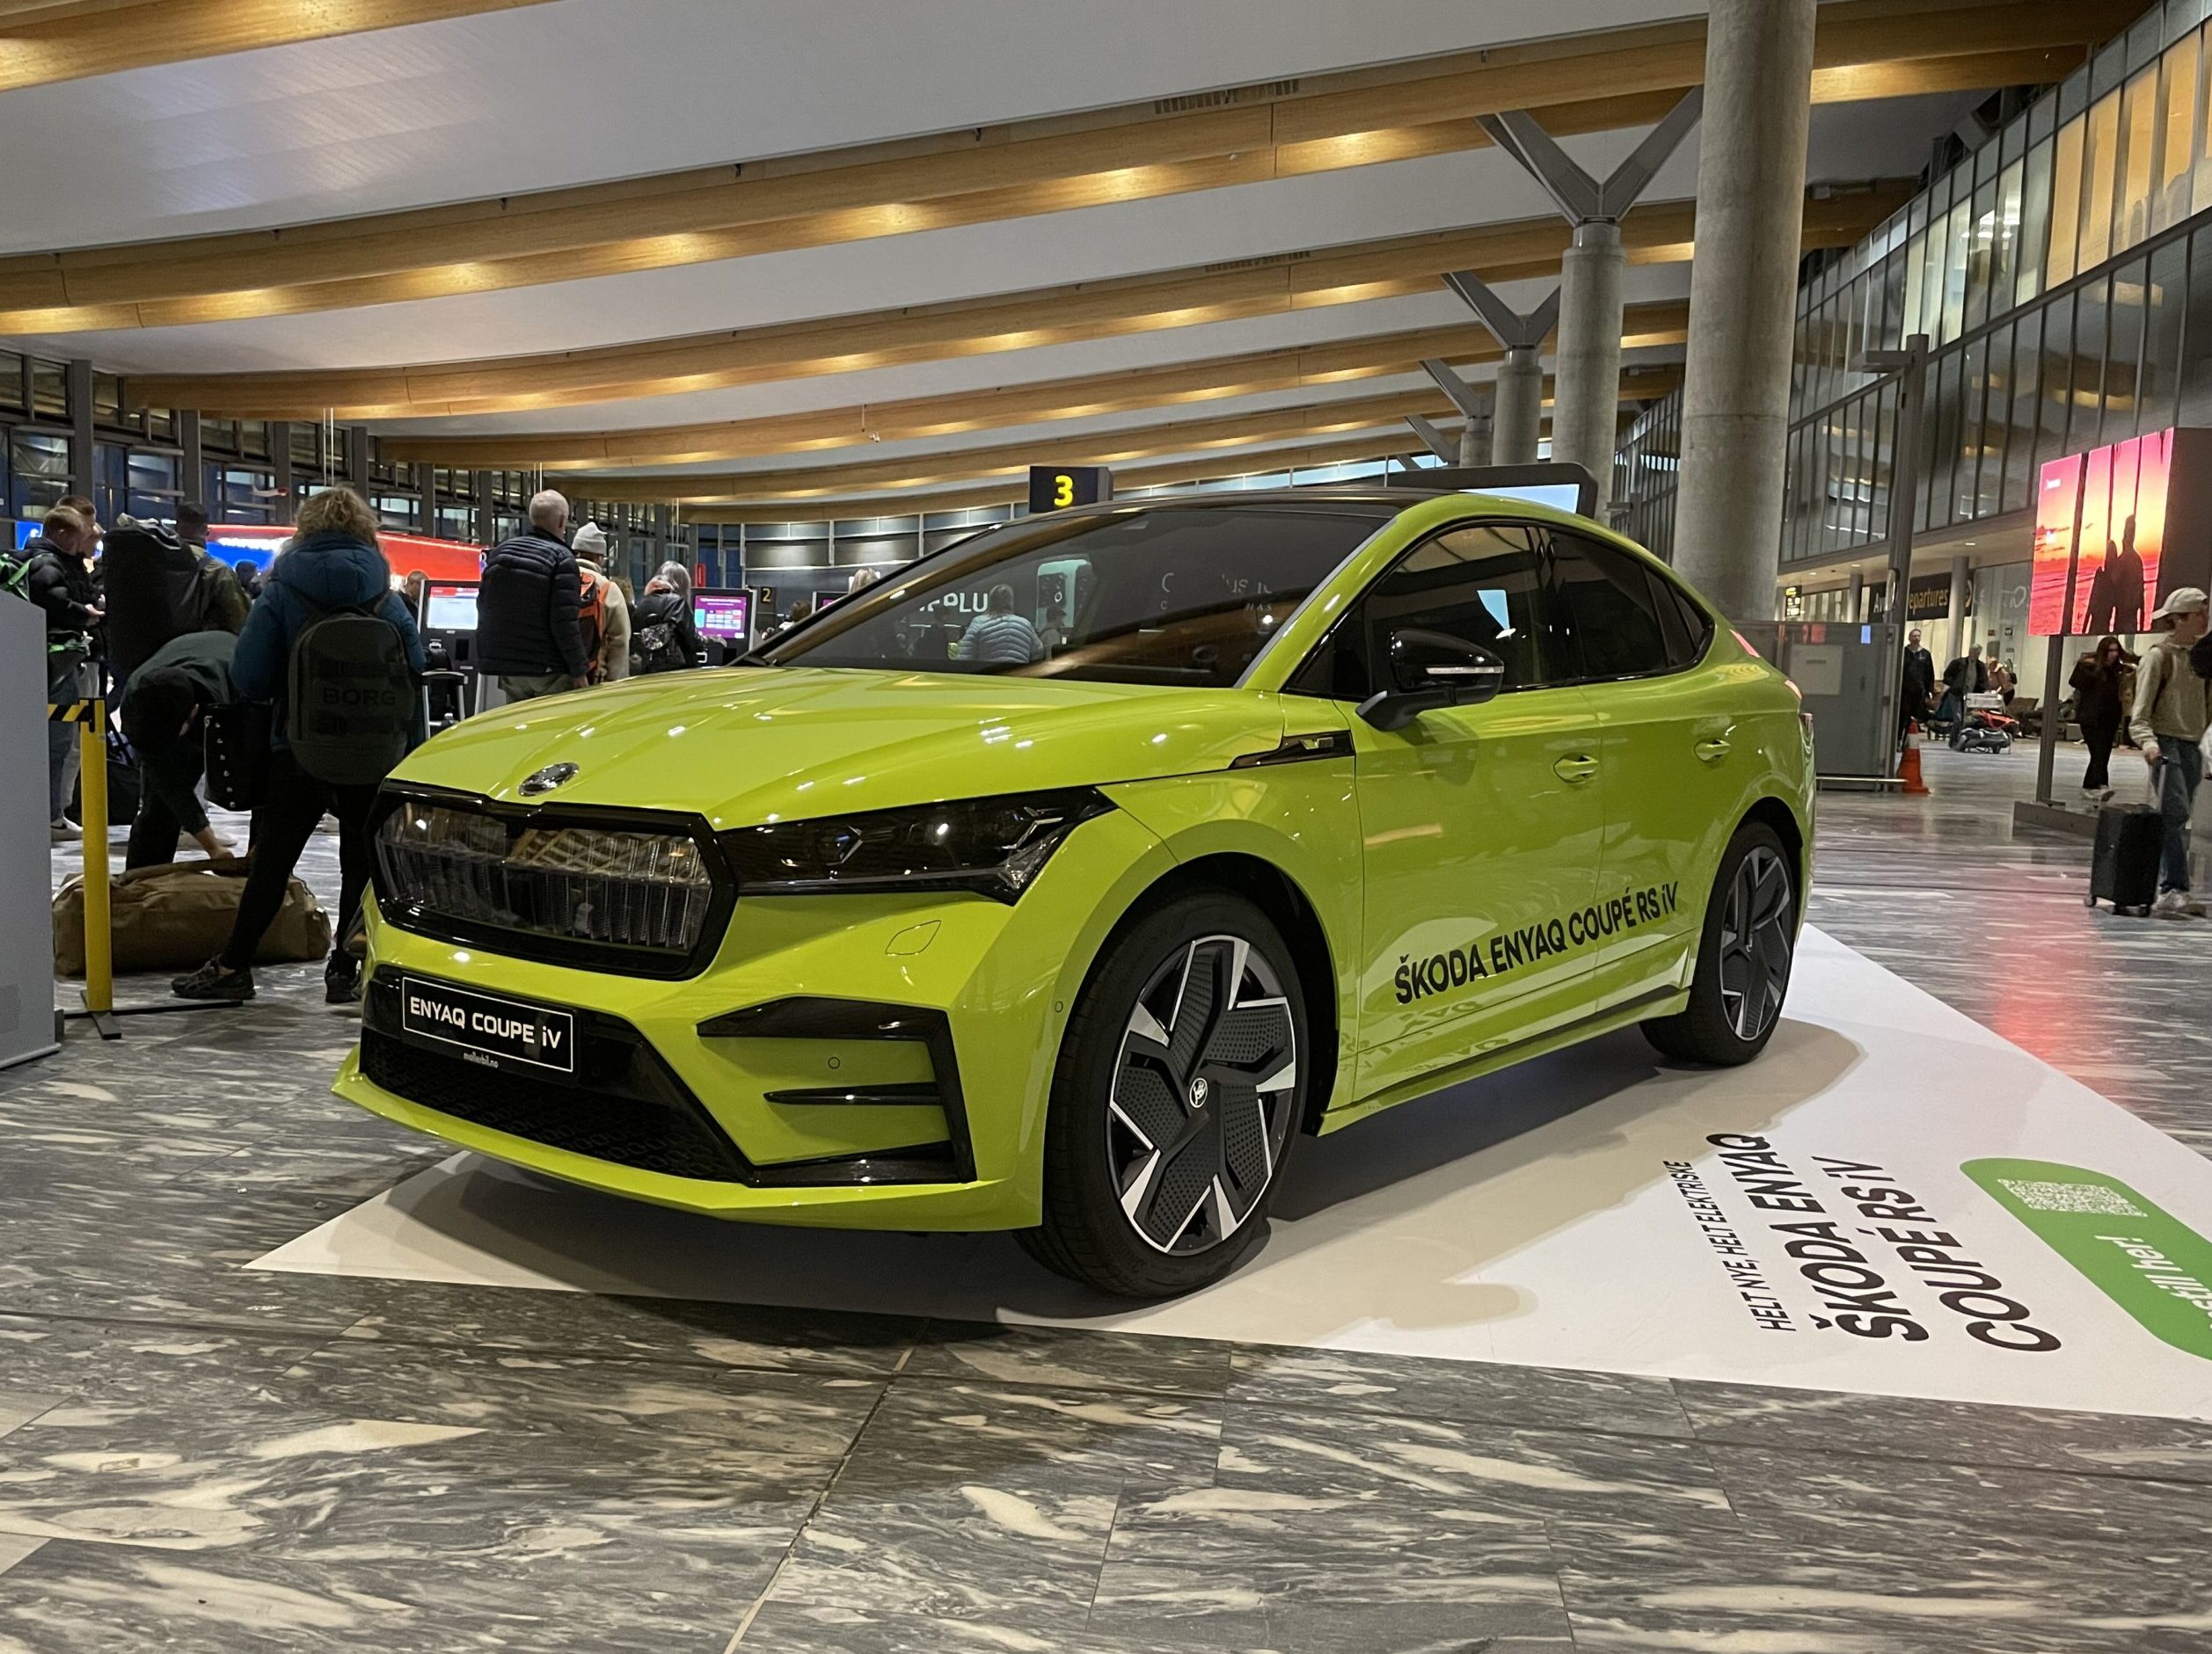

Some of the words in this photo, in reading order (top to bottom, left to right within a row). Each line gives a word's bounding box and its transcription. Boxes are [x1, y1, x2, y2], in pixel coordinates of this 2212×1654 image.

[1054, 475, 1073, 506] 3
[762, 587, 772, 602] 2
[1909, 587, 1950, 616] epartures
[323, 688, 397, 706] BORG
[1394, 944, 1489, 1005] ŠKODA
[1490, 918, 1569, 974] ENYAQ
[1568, 886, 1637, 946] COUPÉ
[1636, 886, 1661, 923] RS
[409, 995, 466, 1030] ENYAQ
[471, 1012, 536, 1045] COUPE
[542, 1025, 562, 1049] iV
[1662, 1160, 1728, 1223] ELEKTRISKE
[1705, 1133, 1827, 1213] ENYAQ
[1841, 1186, 1938, 1223] RS
[1701, 1224, 1748, 1256] HELT
[2094, 1235, 2184, 1272] her!
[1722, 1259, 1770, 1290] NYE,
[1769, 1221, 1930, 1342] ŠKODA
[1855, 1226, 2062, 1352] COUPÉ
[1741, 1291, 1797, 1332] HELT
